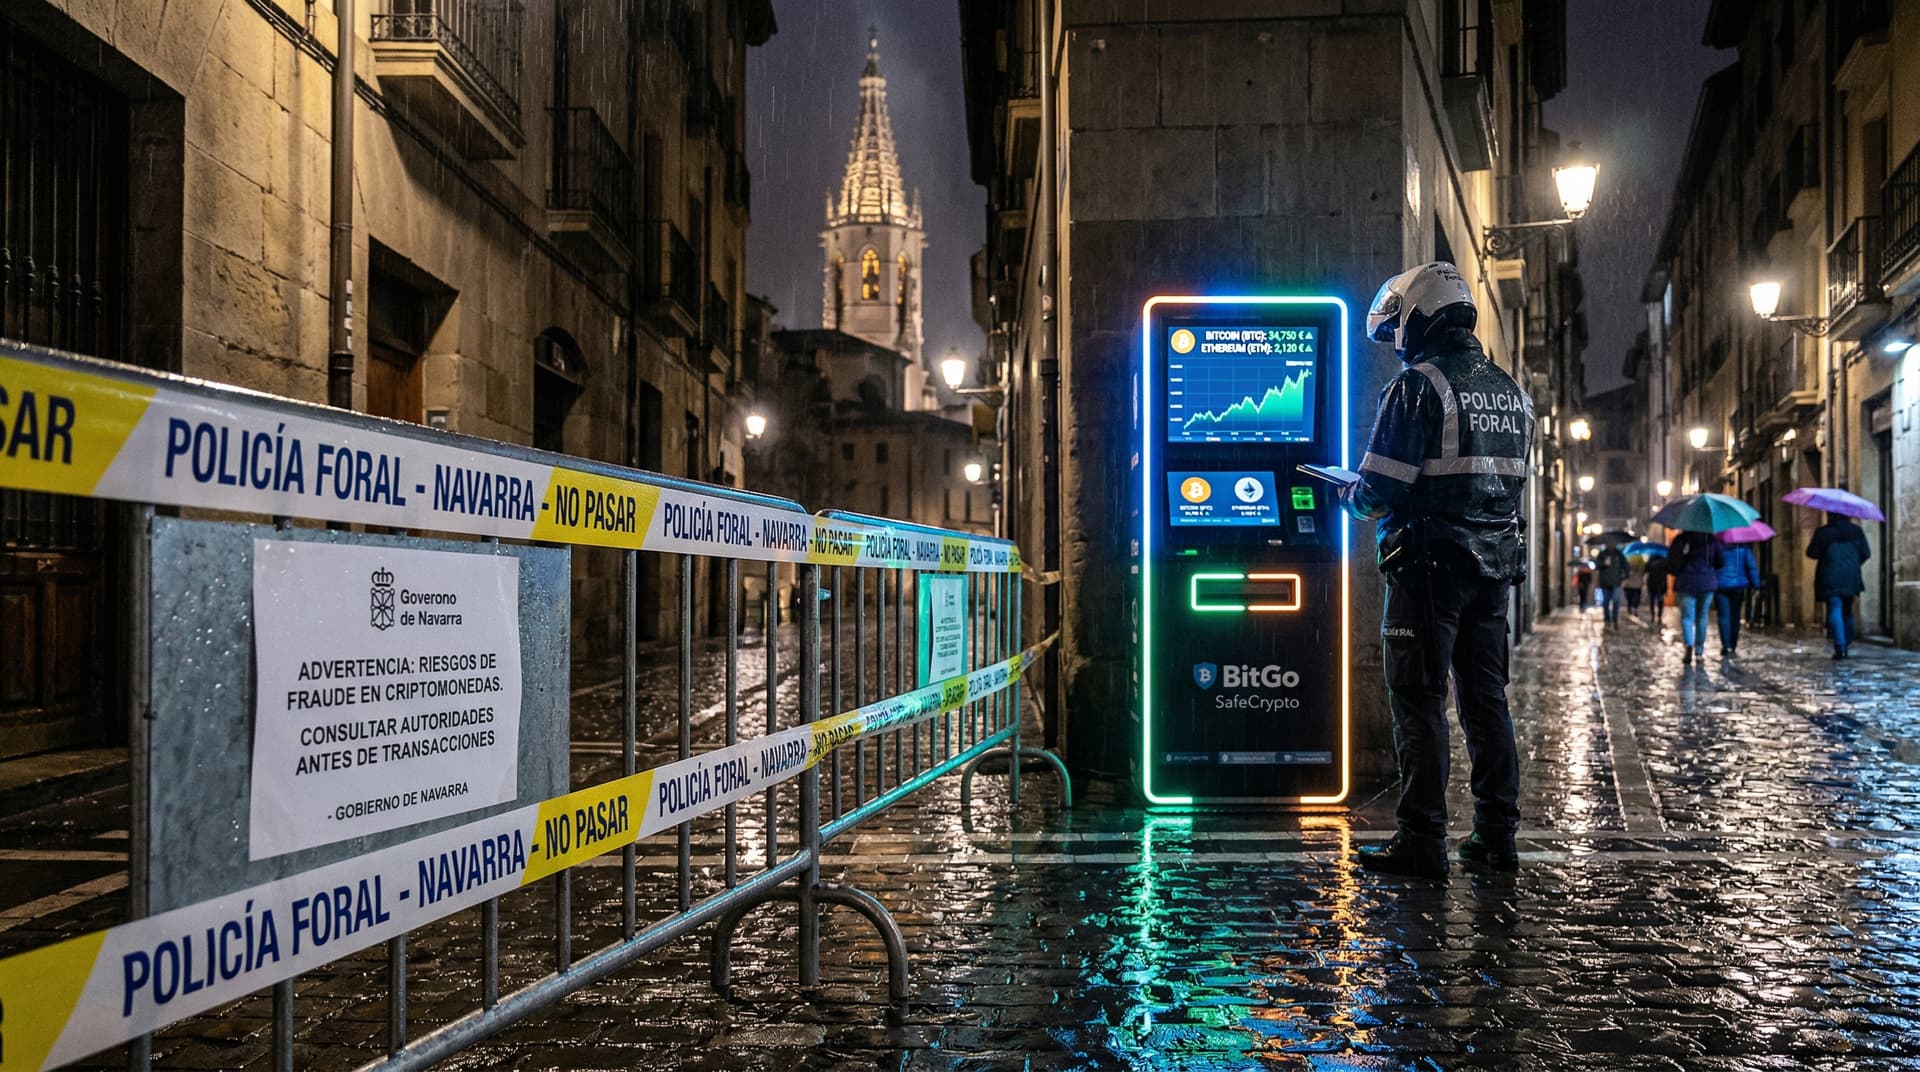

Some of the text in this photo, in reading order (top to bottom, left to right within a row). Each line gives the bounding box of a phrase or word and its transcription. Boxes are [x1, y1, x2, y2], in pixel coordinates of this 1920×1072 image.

[1201, 343, 1246, 353] ETHEREUM
[1274, 343, 1297, 354] 2,120
[1205, 330, 1240, 341] BITCOIN
[1241, 330, 1267, 342] (BTC):
[1268, 330, 1296, 341] 34,750
[1469, 413, 1521, 434] FORAL
[165, 415, 304, 494] POLICÍA
[315, 444, 406, 507] FORAL
[434, 463, 535, 522] NAVARRA
[554, 484, 579, 527] NO
[584, 489, 636, 534] PASAR
[663, 501, 714, 541] POLICÍA
[716, 511, 752, 547] FORAL
[762, 518, 807, 552] NAVARRA
[815, 527, 827, 554] NO
[400, 589, 457, 606] Goverono
[400, 610, 462, 626] de Navarra
[298, 653, 497, 681] ADVERTENCIA: RIESGOS DE
[1223, 664, 1300, 688] BitGo
[287, 675, 503, 711] FRAUDE EN CRIPTOMONEDAS.
[1215, 694, 1300, 712] SafeCrypto
[300, 707, 494, 747] CONSULTAR AUTORIDADES
[295, 730, 495, 776] ANTES DE TRANSACCIONES
[335, 795, 400, 821] GOBIERNO
[403, 791, 418, 807] DE
[421, 782, 469, 804] NAVARRA
[122, 900, 281, 1018] POLICÍA
[292, 874, 390, 956] FORAL
[417, 829, 525, 908] NAVARRA
[545, 816, 571, 860] NO
[576, 795, 629, 848] PASAR
[659, 760, 711, 818] POLICÍA
[714, 762, 752, 796] FORAL
[760, 738, 807, 779] NAVARRA
